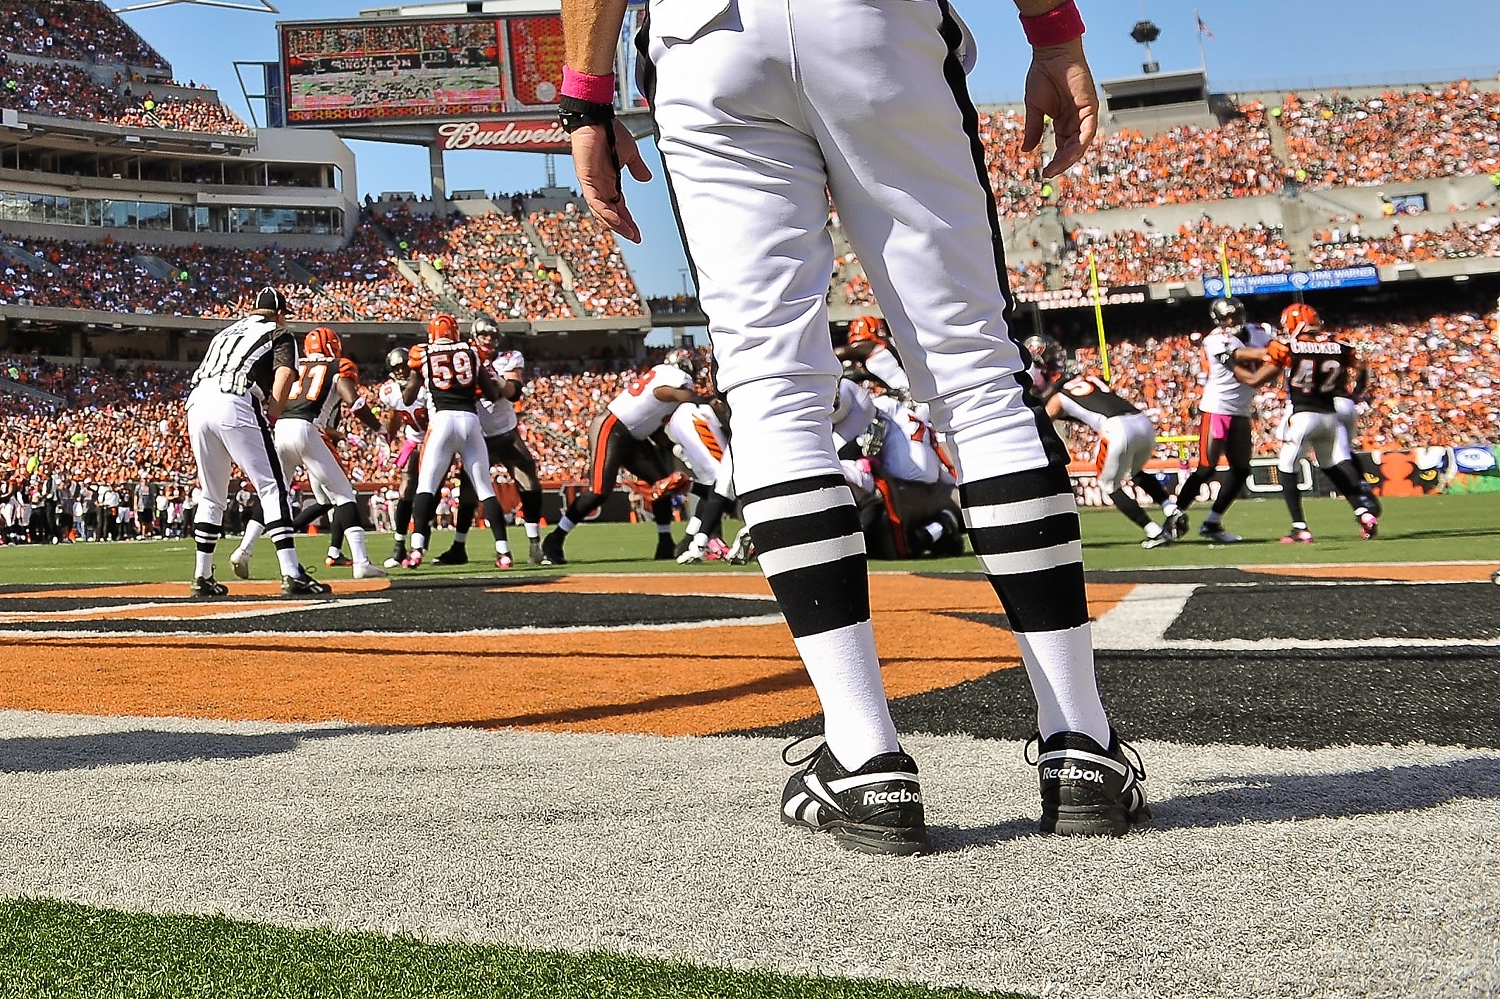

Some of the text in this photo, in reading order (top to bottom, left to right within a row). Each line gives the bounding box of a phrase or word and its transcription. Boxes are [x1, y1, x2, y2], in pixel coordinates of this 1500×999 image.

[438, 121, 570, 149] Budweis
[1248, 274, 1288, 285] WARNER
[1311, 267, 1376, 280] TIME WARNER
[430, 351, 474, 390] 59
[1290, 359, 1341, 393] 42
[1043, 765, 1105, 784] Reebok
[863, 788, 921, 806] Reebo
